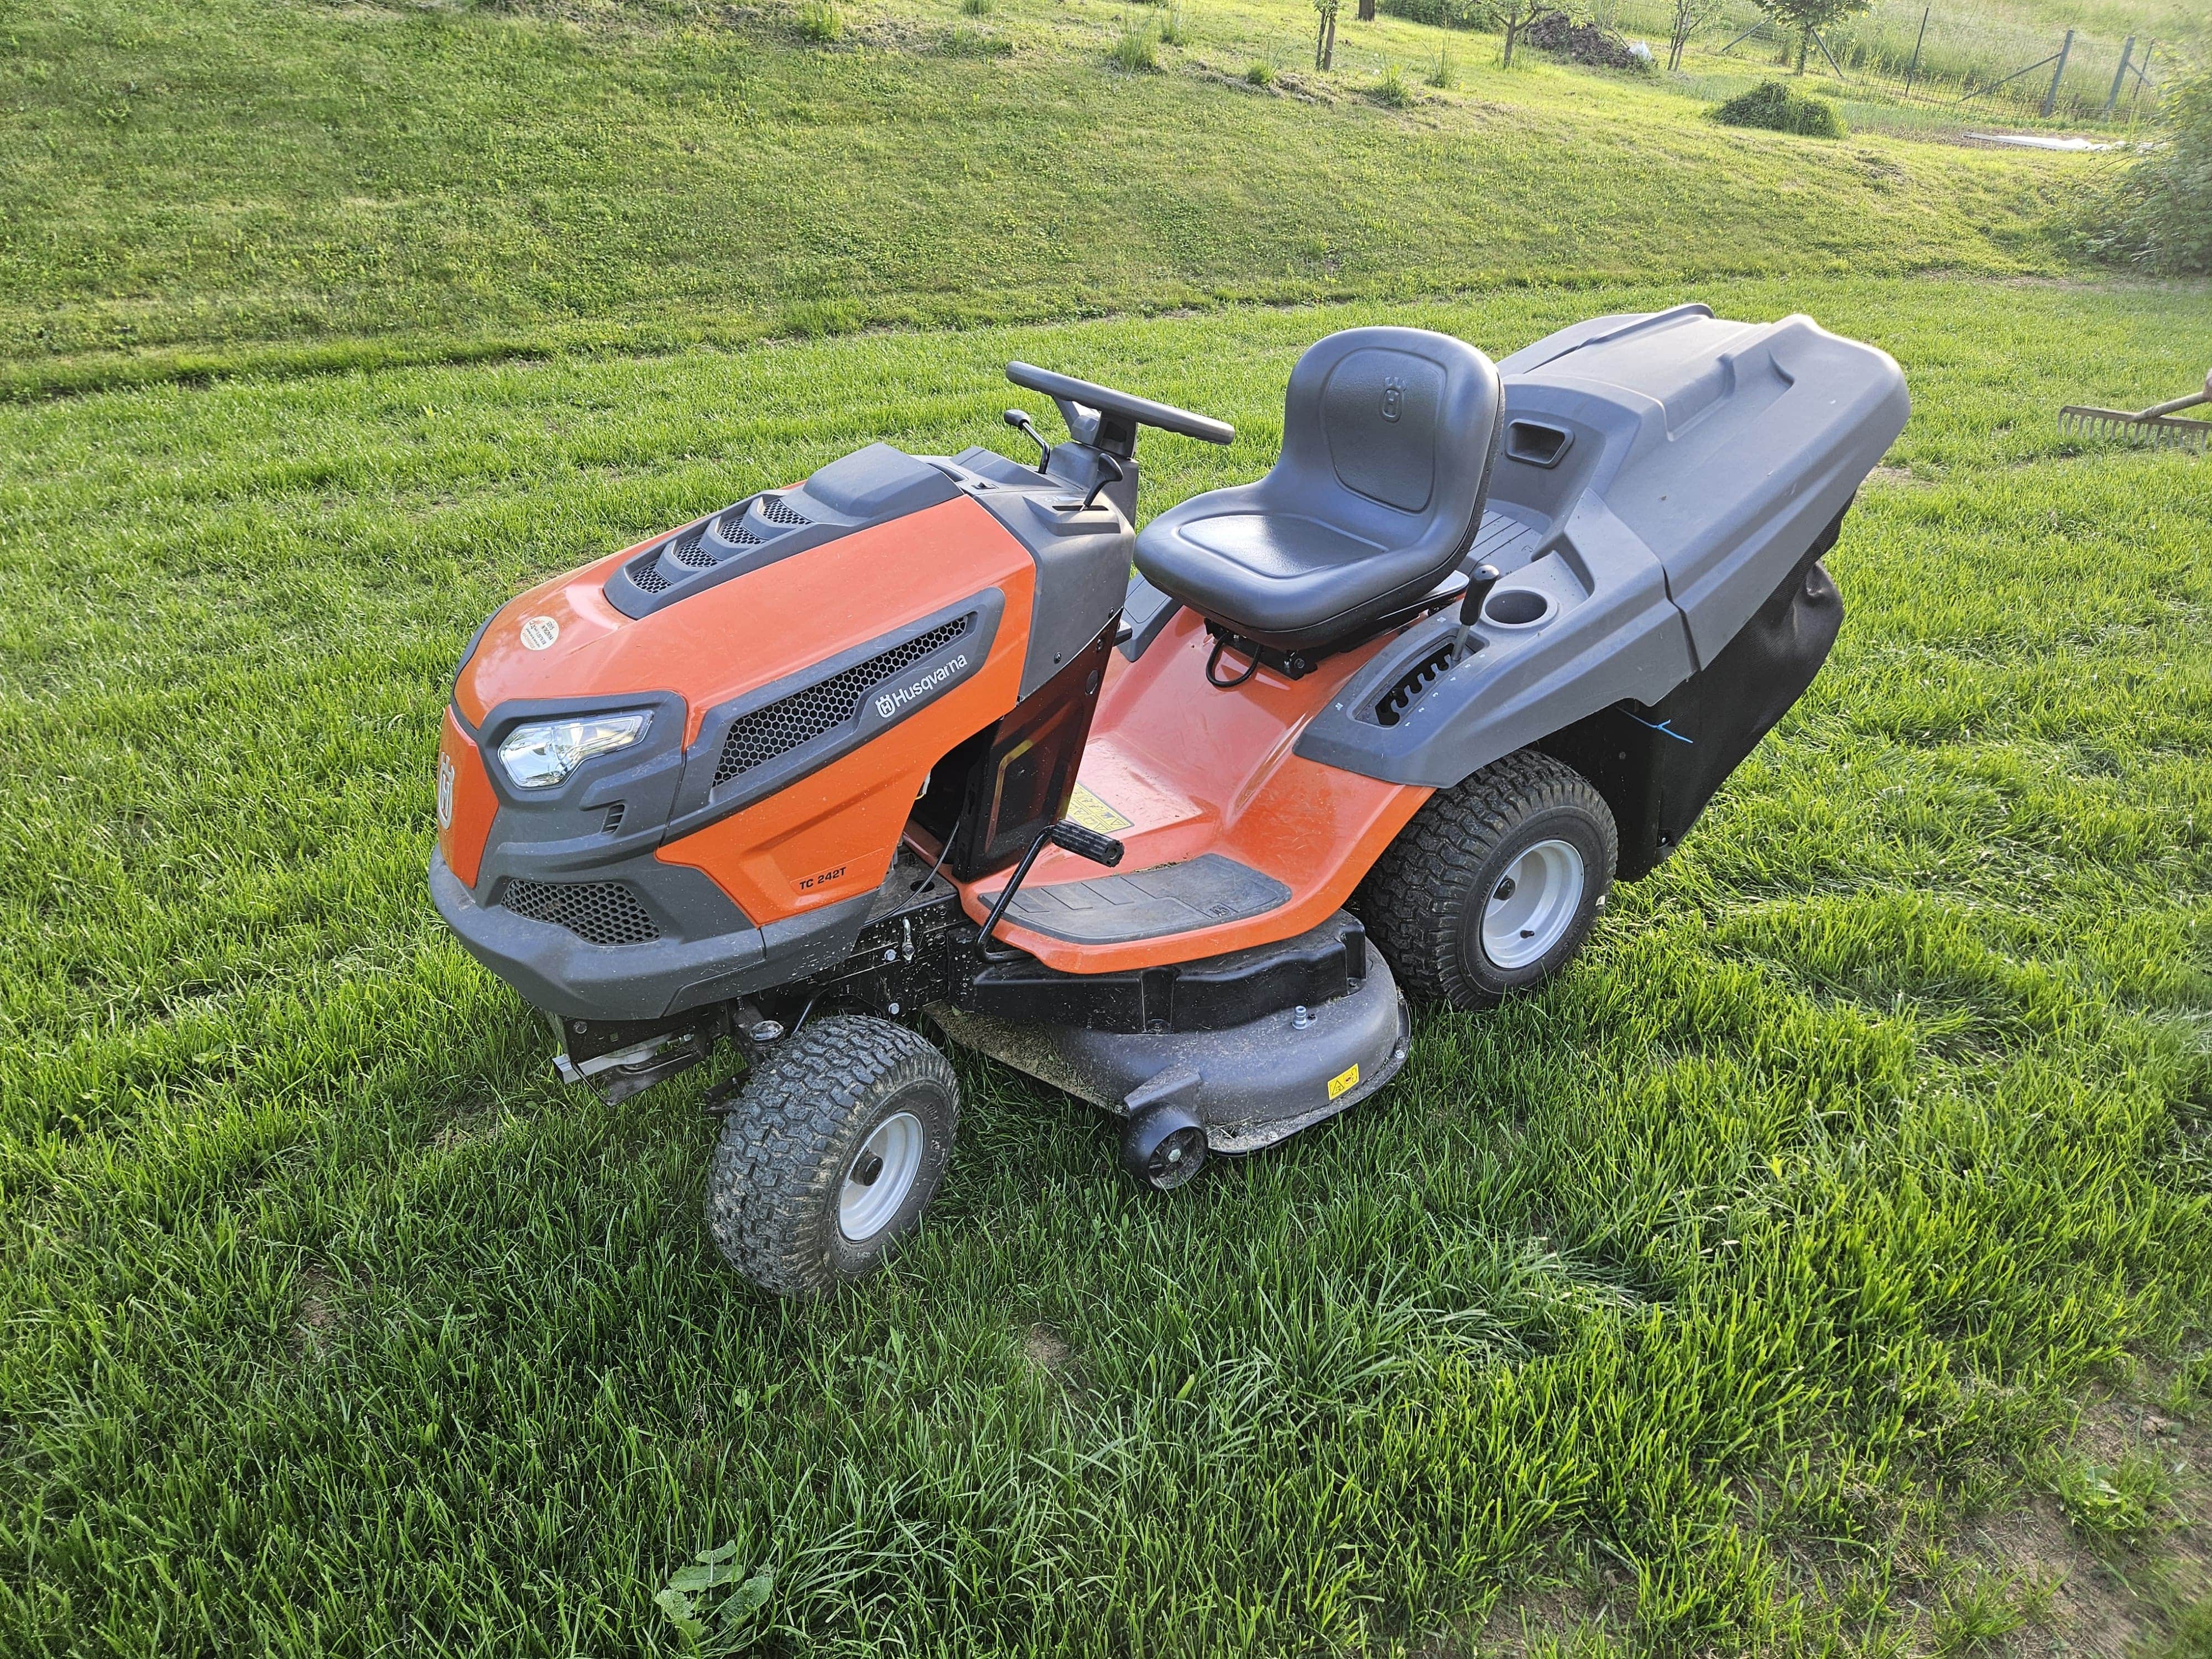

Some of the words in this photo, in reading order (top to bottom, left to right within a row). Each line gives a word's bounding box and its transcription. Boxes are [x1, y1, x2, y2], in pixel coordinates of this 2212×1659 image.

[892, 654, 968, 707] Husqvarna
[799, 879, 813, 890] TC
[817, 867, 846, 884] 242T
